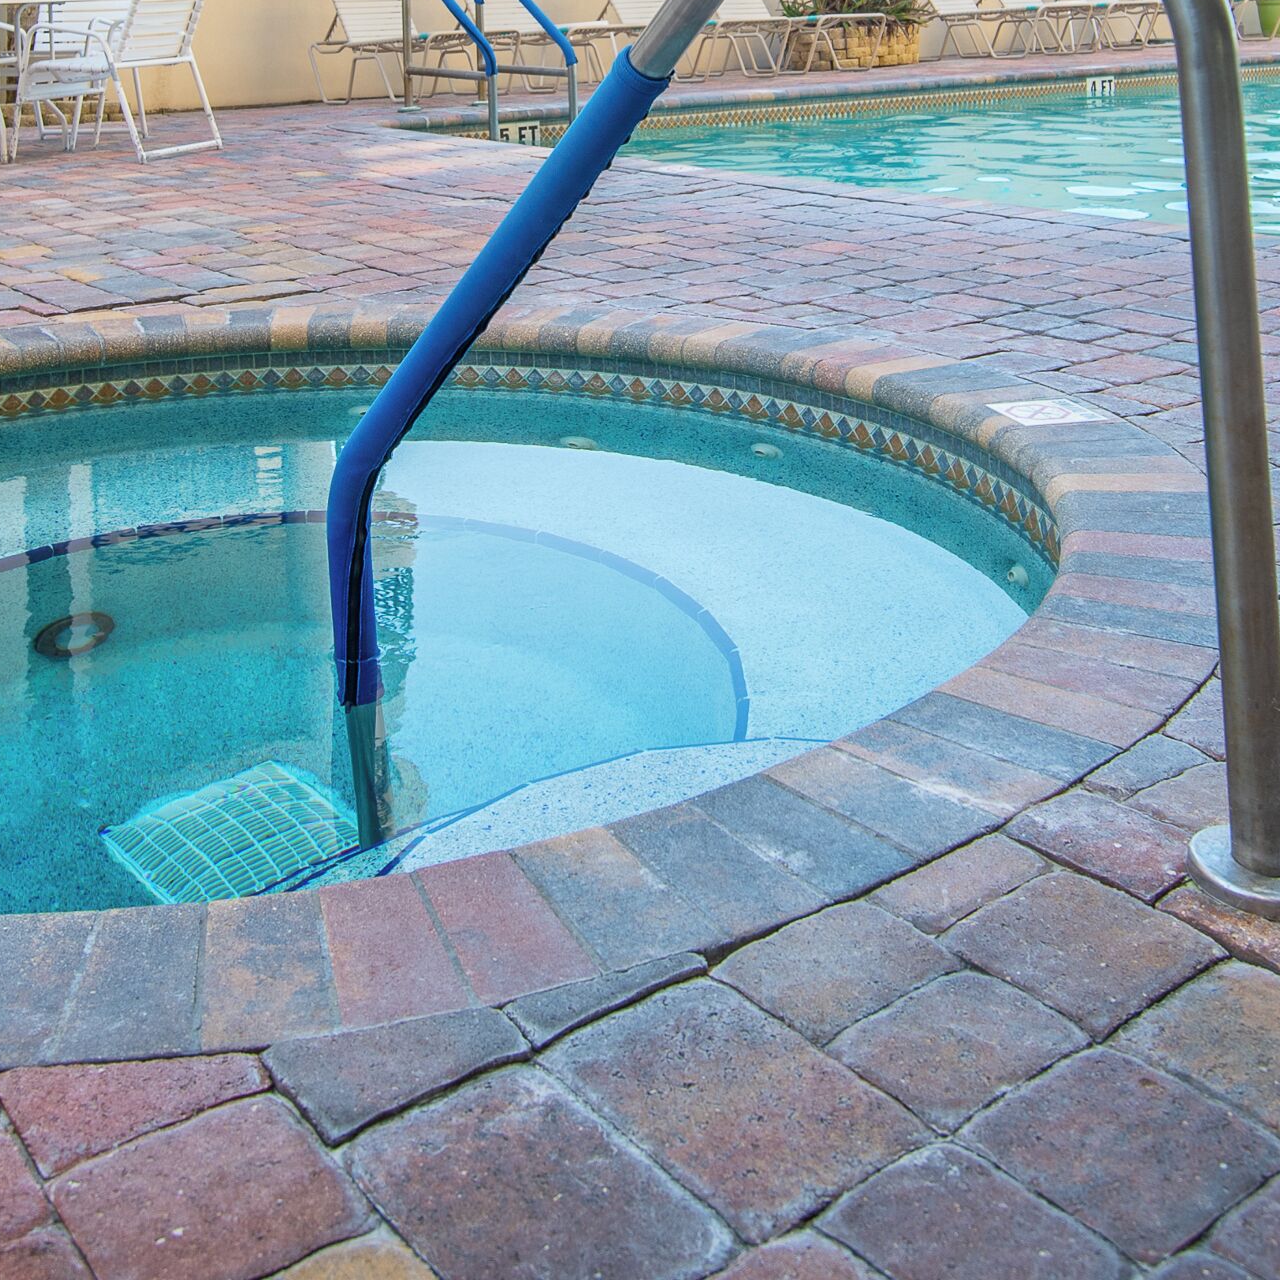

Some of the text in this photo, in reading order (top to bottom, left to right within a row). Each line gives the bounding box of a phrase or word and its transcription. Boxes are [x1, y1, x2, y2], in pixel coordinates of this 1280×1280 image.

[1101, 79, 1113, 96] FT
[500, 125, 538, 146] 5 FT
